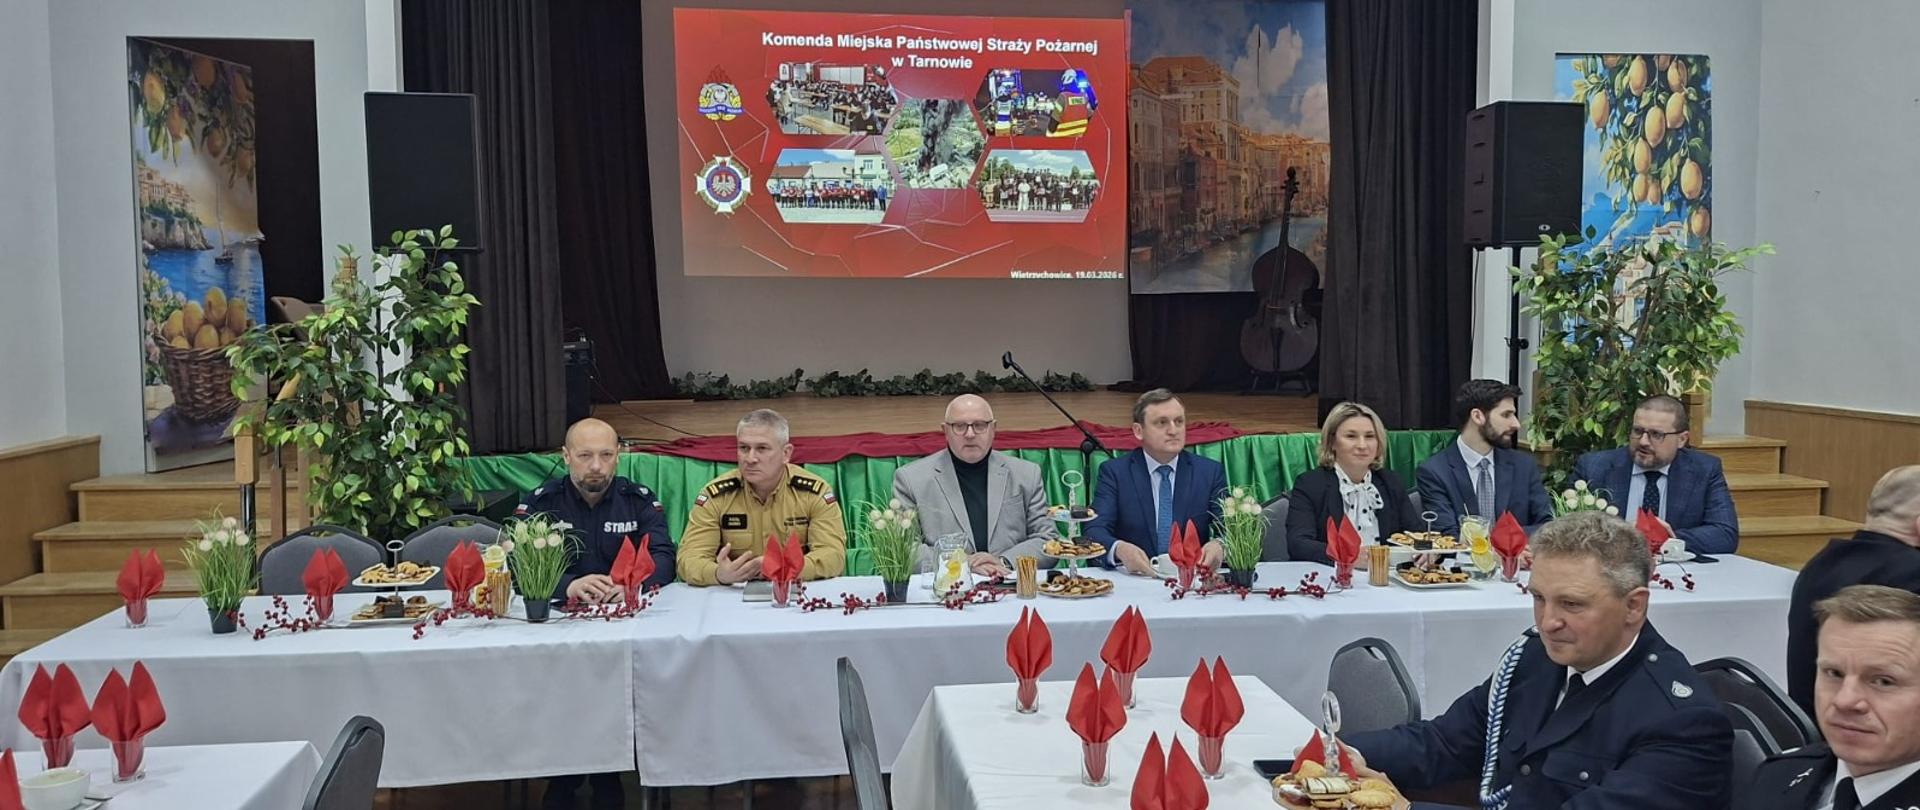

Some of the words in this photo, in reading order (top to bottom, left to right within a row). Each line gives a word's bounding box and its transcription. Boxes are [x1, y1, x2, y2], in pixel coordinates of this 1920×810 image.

[762, 32, 833, 46] Komenda
[837, 34, 892, 51] Miejska
[896, 36, 983, 53] Państwowej
[987, 38, 1032, 54] Straży
[1036, 39, 1098, 55] Pożarnej
[891, 56, 904, 67] w
[907, 55, 973, 69] Tarnowie
